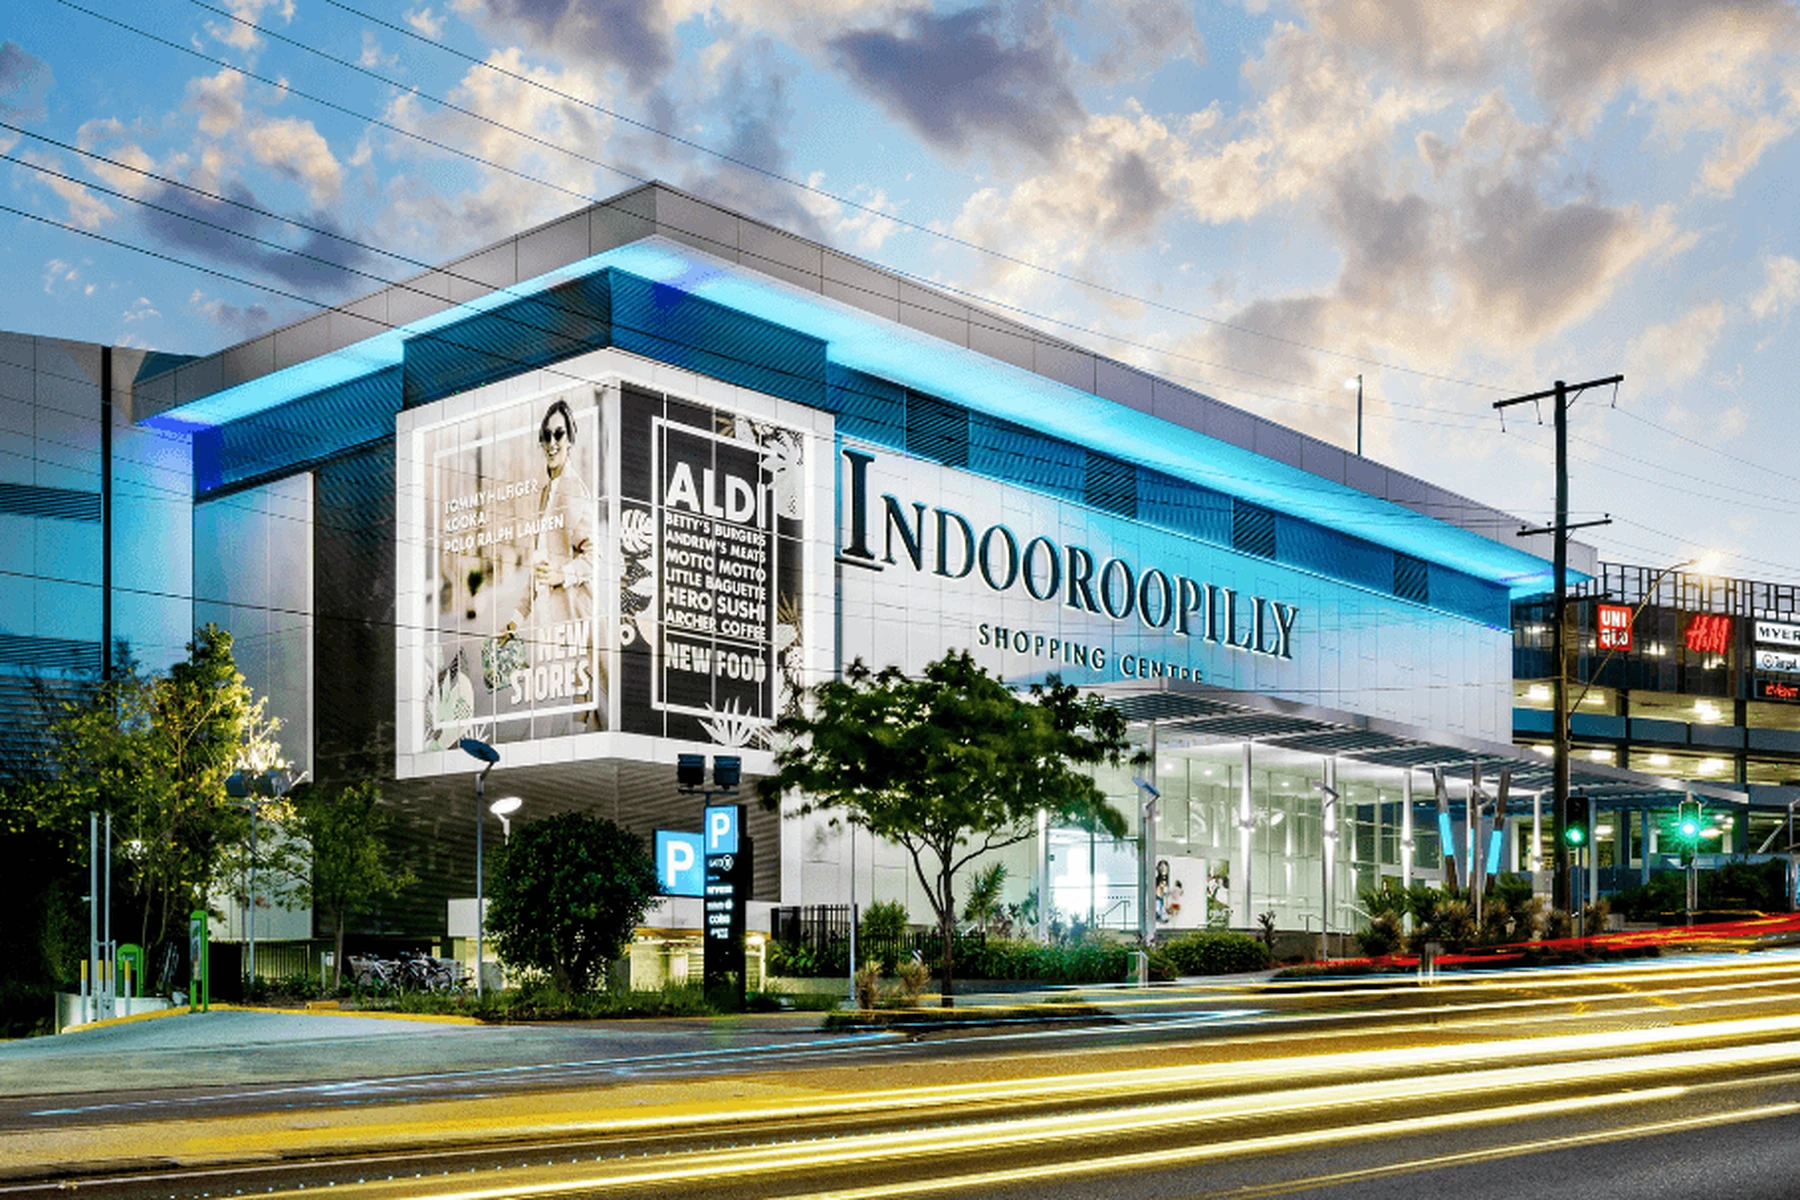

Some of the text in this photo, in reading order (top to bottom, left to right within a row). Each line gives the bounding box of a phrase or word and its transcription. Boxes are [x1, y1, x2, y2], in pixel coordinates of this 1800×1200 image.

[444, 491, 486, 514] TOMMY
[667, 461, 766, 529] ALDI
[444, 514, 564, 553] POLO RALPH LAUREN
[666, 512, 766, 546] BETTY'S BURGERS
[666, 529, 766, 563] ANDREW'S MEATS
[666, 547, 766, 581] MOTTO MOTTO
[837, 449, 1299, 661] INDOOROOPILLY
[665, 567, 766, 600] LITTLE BAGUETTE
[666, 585, 766, 621] HERO SUSHI
[1601, 610, 1627, 628] UNI
[539, 621, 590, 661] NEW
[666, 609, 766, 640] ARCHER COFFEE
[666, 641, 766, 683] NEW FOOD
[978, 624, 1106, 671] SHOPPING
[510, 660, 590, 705] STORES
[711, 812, 731, 849] P
[666, 840, 695, 887] P
